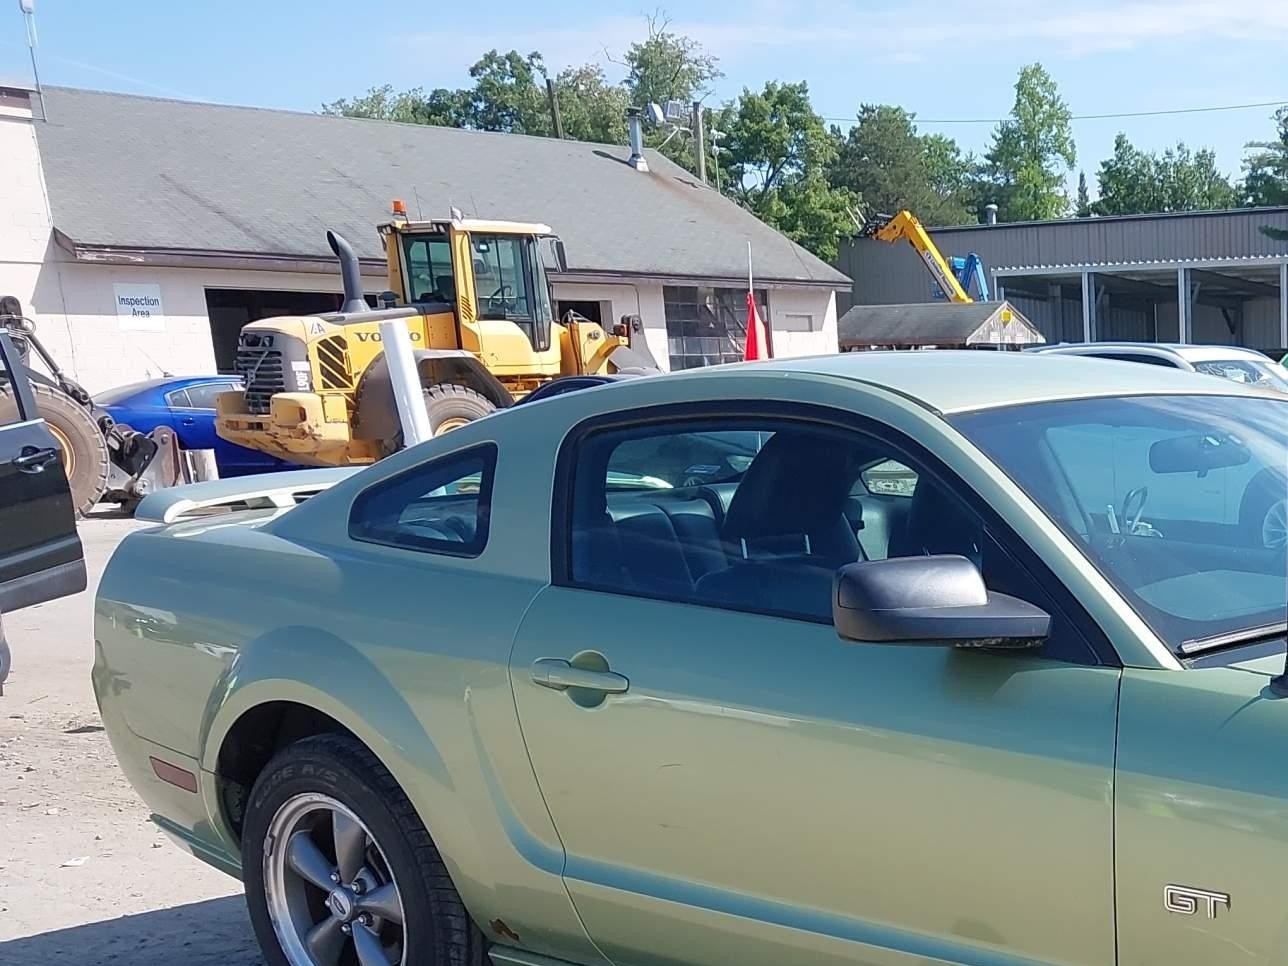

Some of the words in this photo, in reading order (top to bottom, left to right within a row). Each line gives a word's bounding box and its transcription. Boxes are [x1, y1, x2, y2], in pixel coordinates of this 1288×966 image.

[117, 295, 160, 307] Inspection
[132, 307, 150, 318] Area
[354, 331, 422, 342] VOO
[1163, 884, 1230, 919] GT
